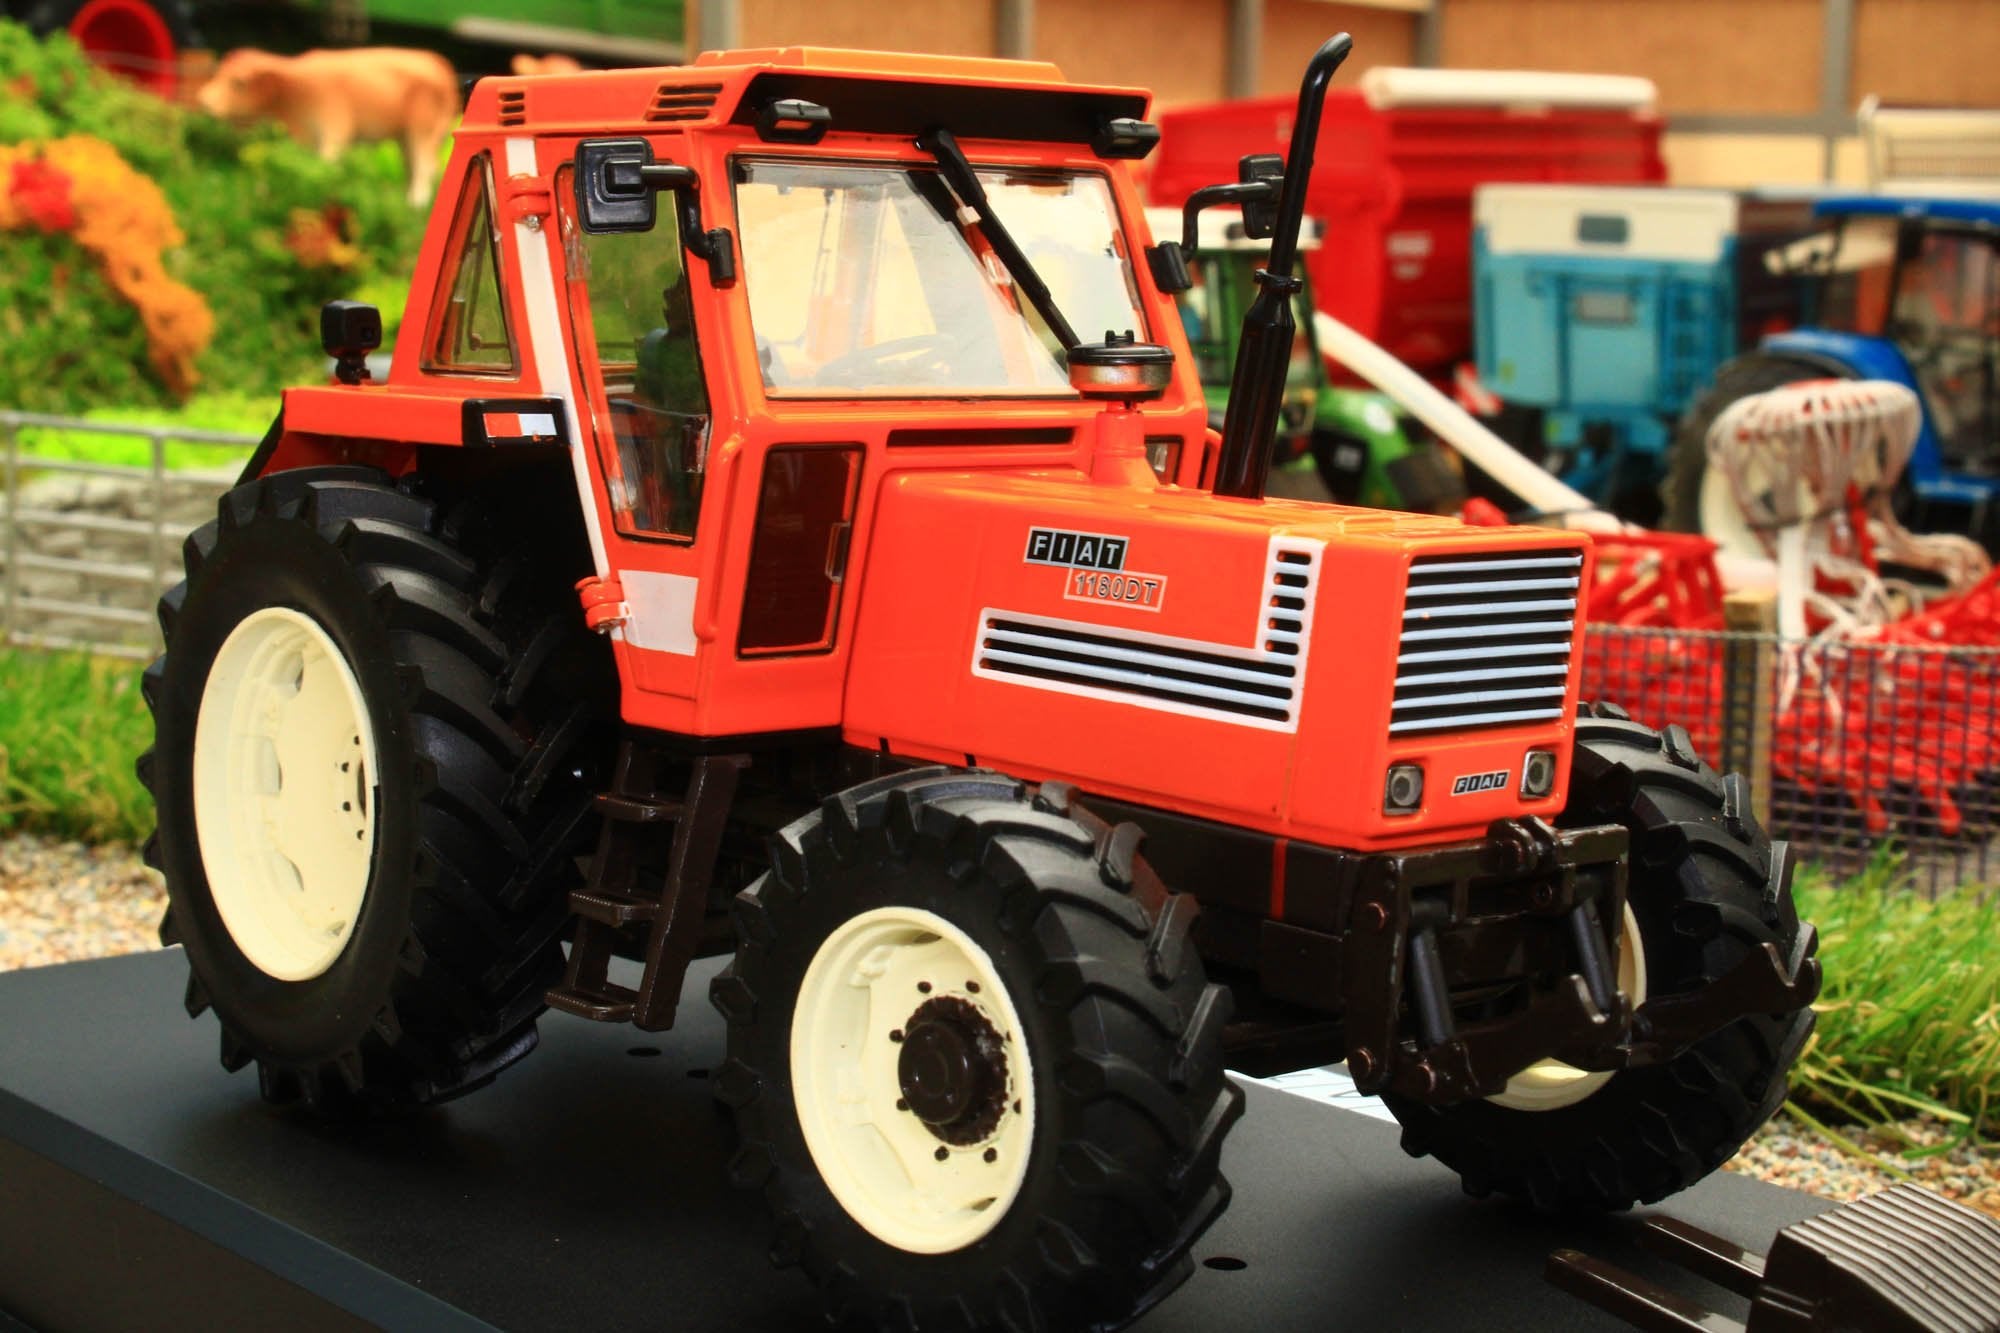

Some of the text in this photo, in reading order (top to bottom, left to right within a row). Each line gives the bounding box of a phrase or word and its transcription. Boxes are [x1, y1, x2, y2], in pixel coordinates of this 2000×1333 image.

[1032, 534, 1121, 566] FIAT
[1074, 571, 1158, 604] 1180DT
[1455, 774, 1506, 792] FIAT
